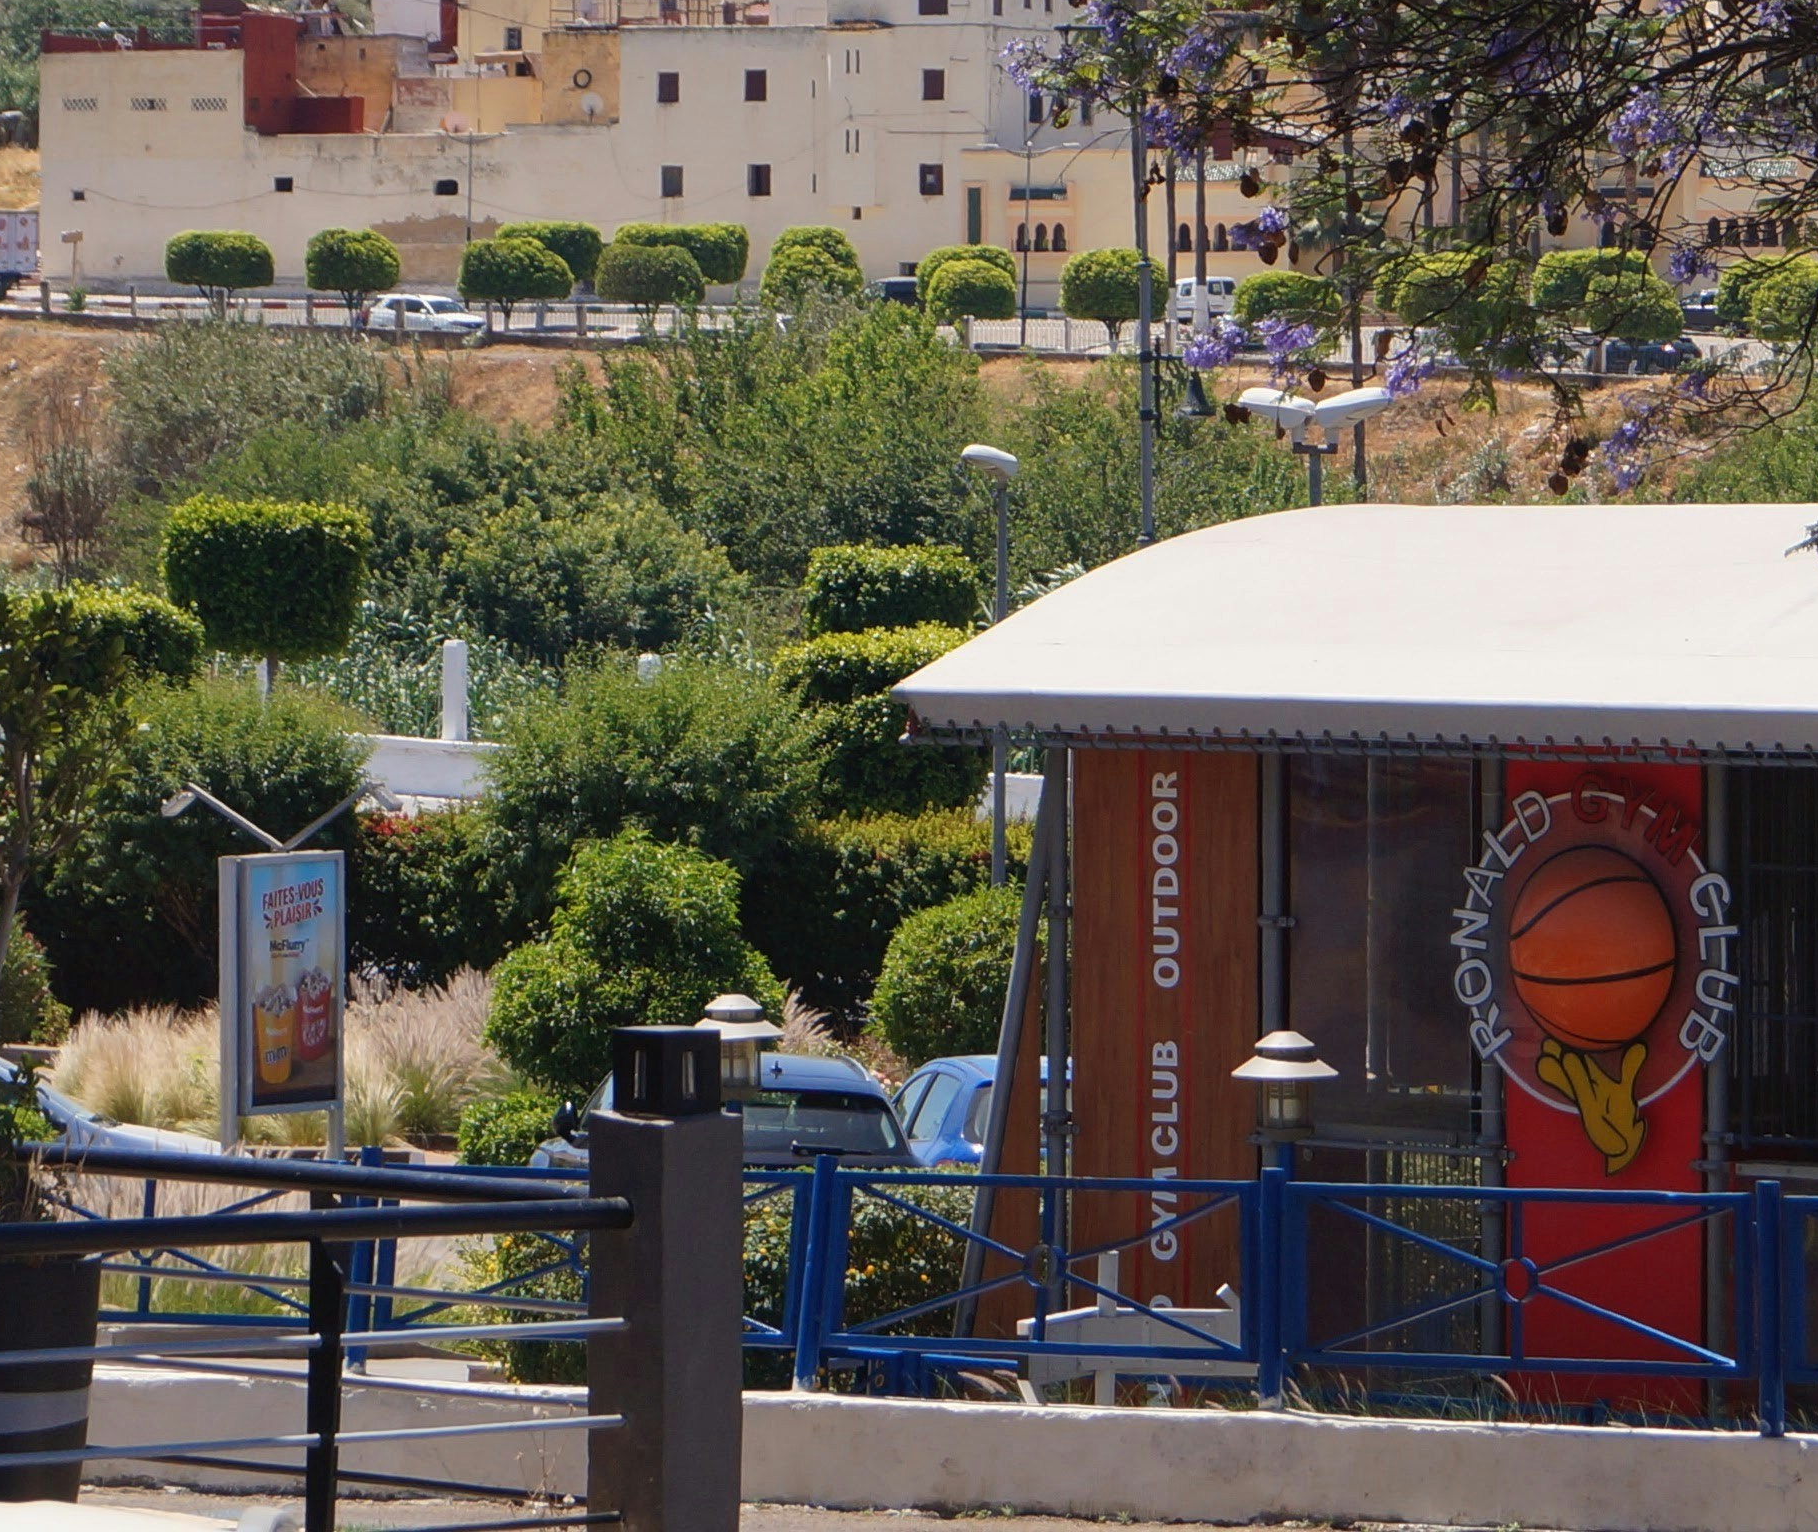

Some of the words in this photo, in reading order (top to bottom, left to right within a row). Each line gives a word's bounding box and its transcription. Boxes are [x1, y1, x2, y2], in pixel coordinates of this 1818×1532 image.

[262, 877, 324, 910] FAITES-VOUS
[273, 901, 312, 928] PLAISIR
[1151, 770, 1180, 988] OUTDOOR
[1450, 789, 1552, 1060] RONALD
[1570, 771, 1701, 866] GYM
[1679, 872, 1740, 1062] CLUB
